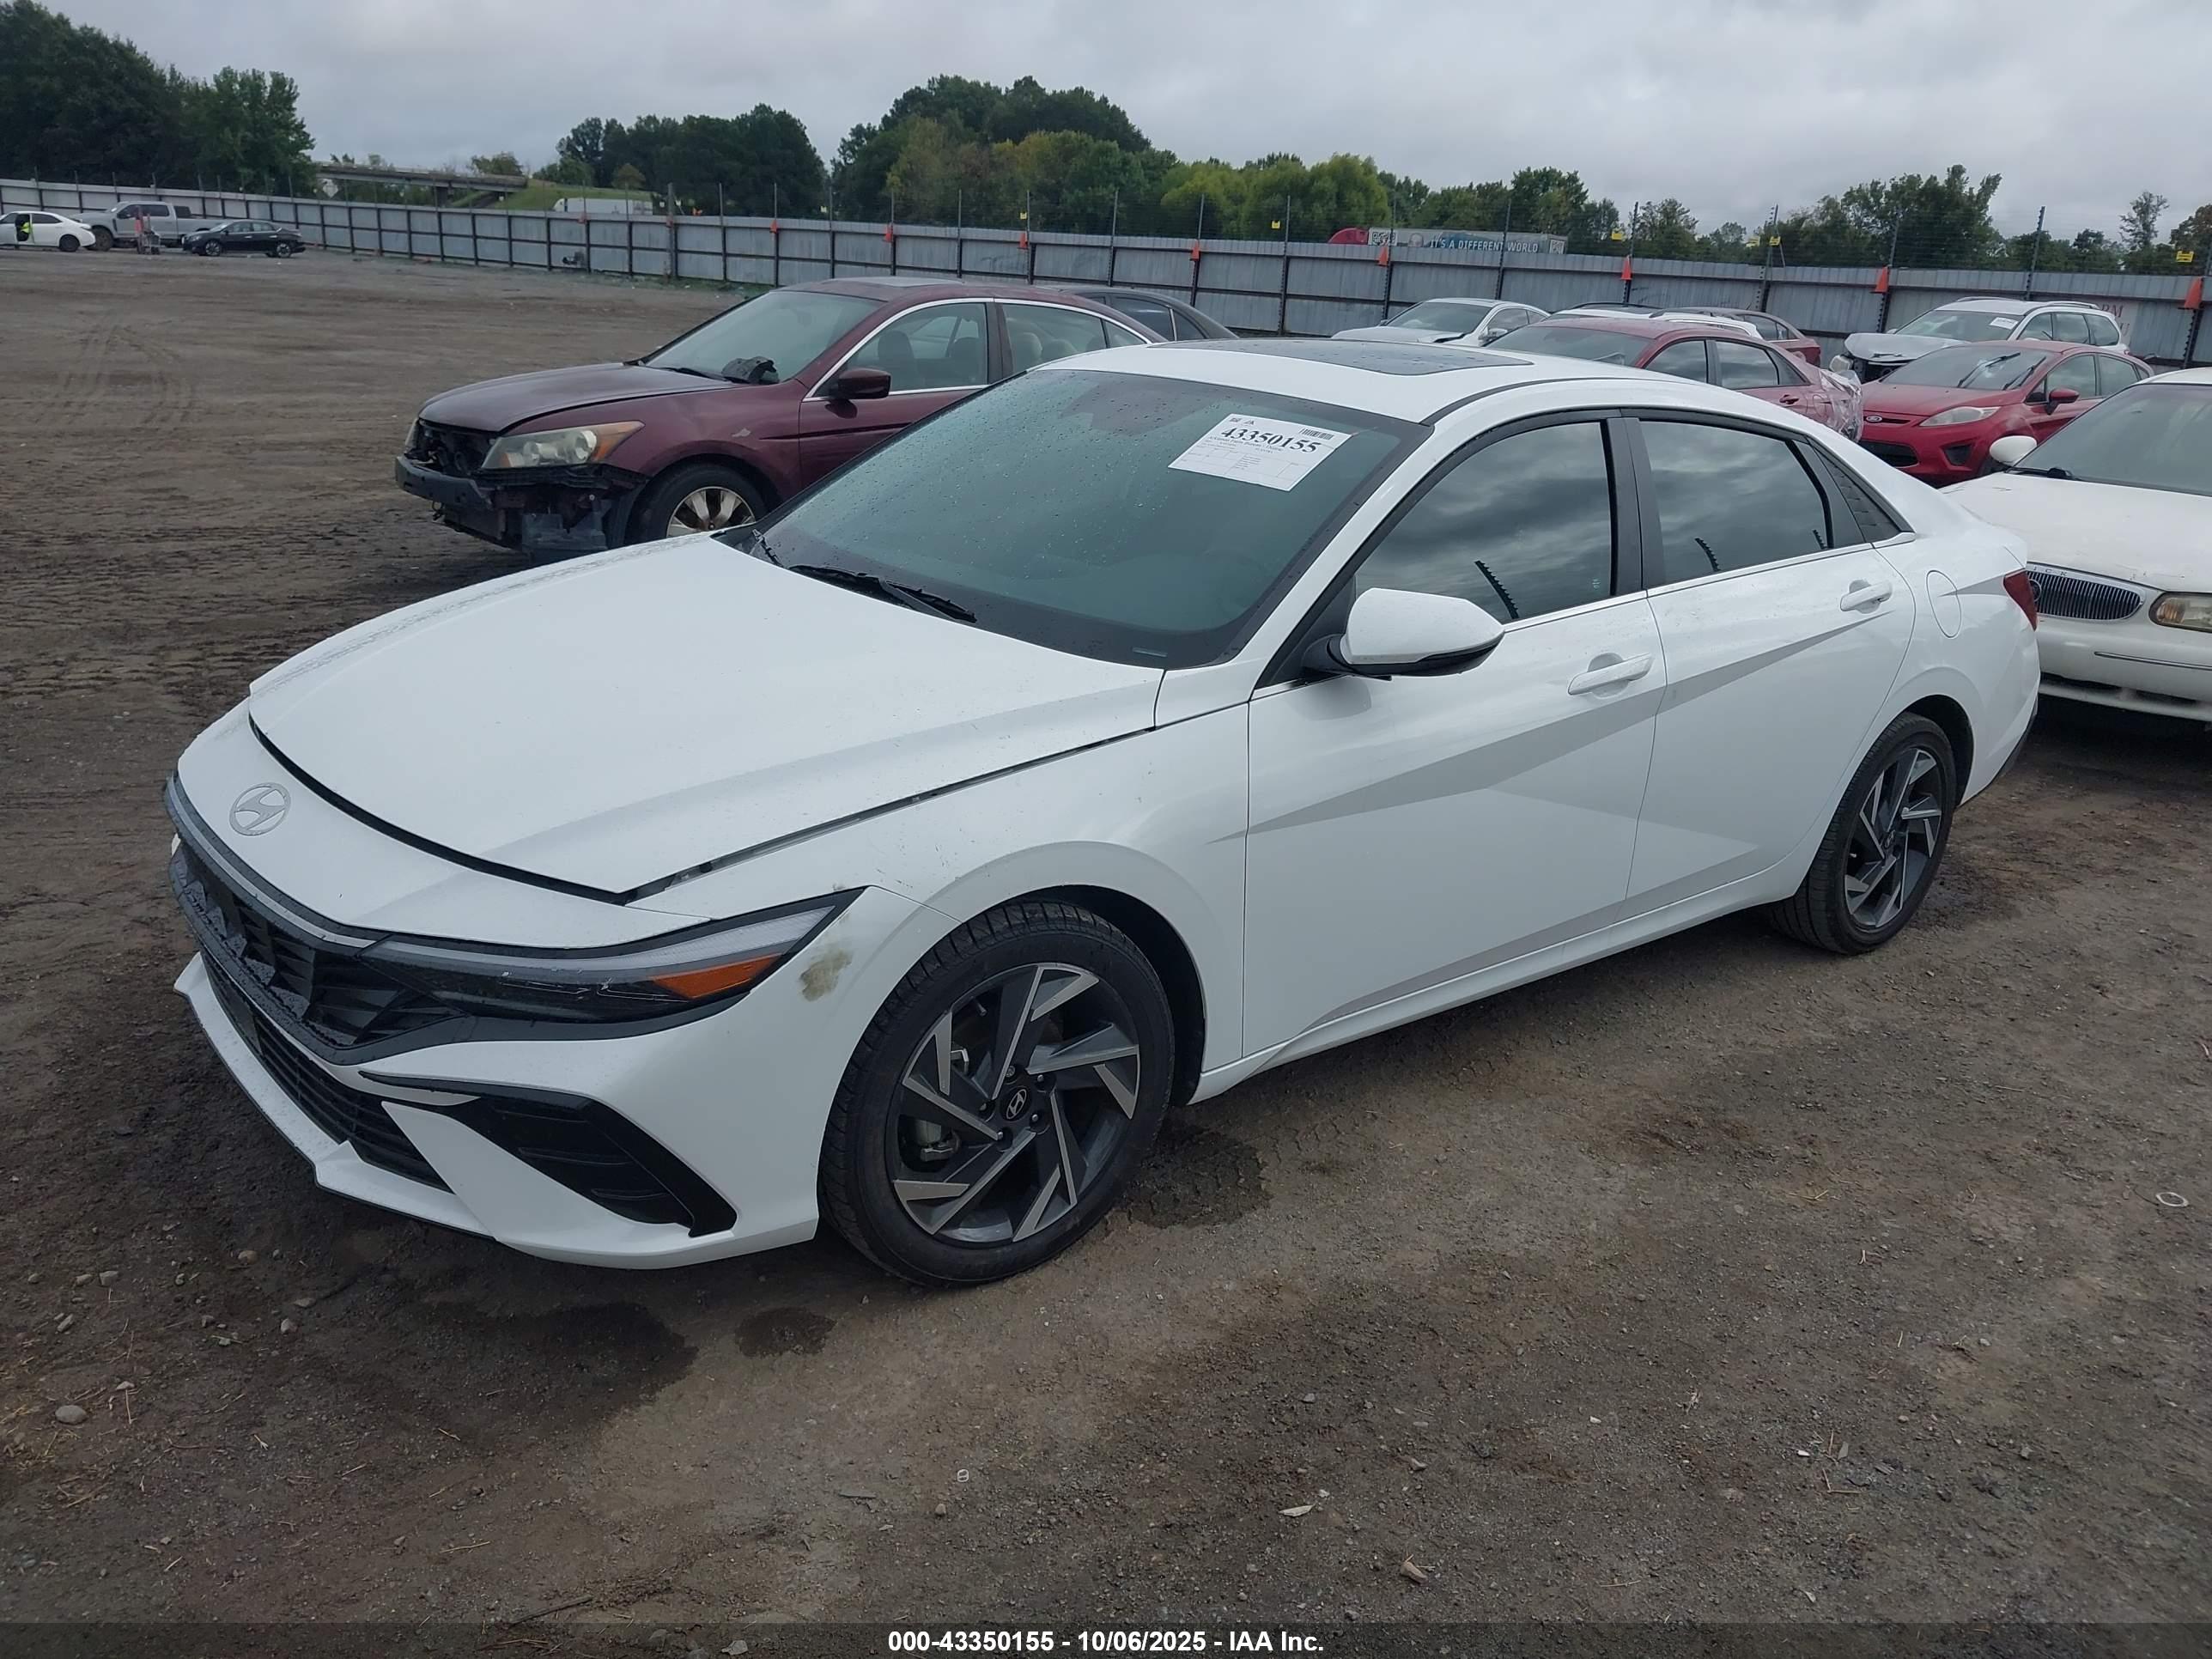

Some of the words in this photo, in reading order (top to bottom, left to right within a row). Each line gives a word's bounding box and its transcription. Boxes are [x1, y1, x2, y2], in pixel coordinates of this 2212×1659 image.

[1449, 240, 1455, 249] A
[1458, 240, 1504, 252] DIFFERENT
[1507, 241, 1539, 252] WORLD
[1220, 428, 1322, 453] 43350155
